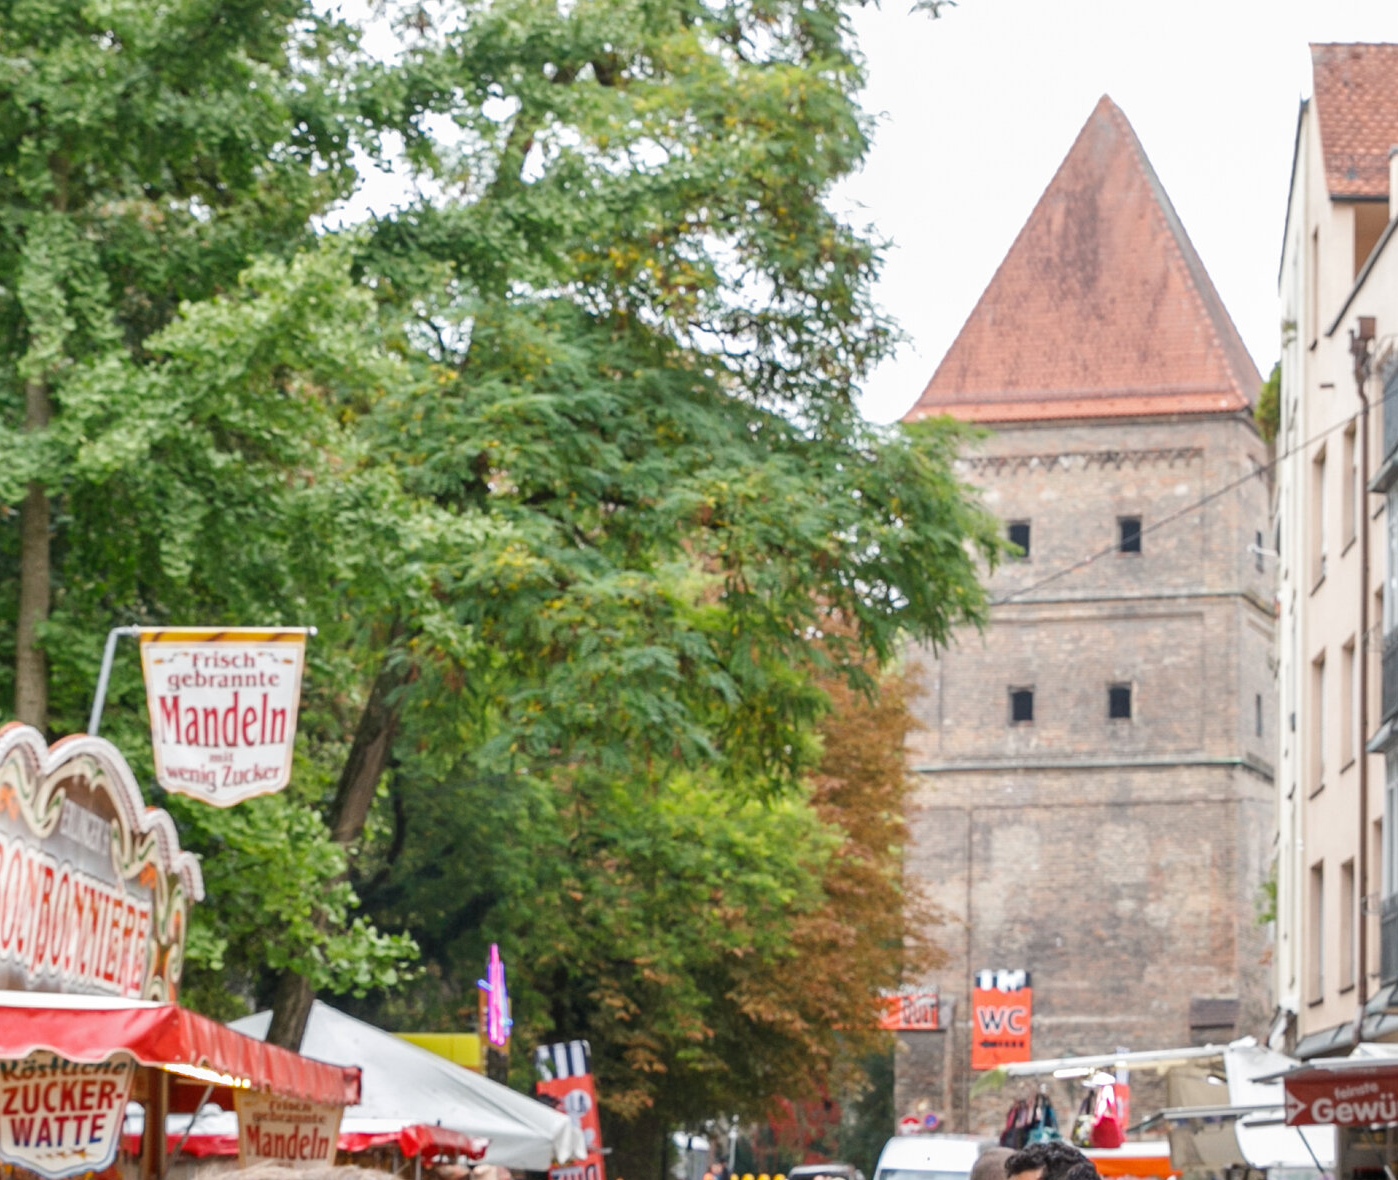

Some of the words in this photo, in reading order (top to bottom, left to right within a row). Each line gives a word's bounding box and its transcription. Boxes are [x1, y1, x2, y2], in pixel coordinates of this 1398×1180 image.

[192, 651, 255, 668] Frisch
[168, 671, 279, 691] gebrannte
[159, 691, 287, 748] Mandeln
[209, 752, 234, 763] mit
[166, 764, 217, 793] wenig
[222, 763, 280, 788] Zucker
[978, 1006, 1026, 1033] WC
[2, 1079, 123, 1116] ZUCKER-
[10, 1113, 106, 1148] WATTE
[245, 1125, 330, 1160] Mandeln
